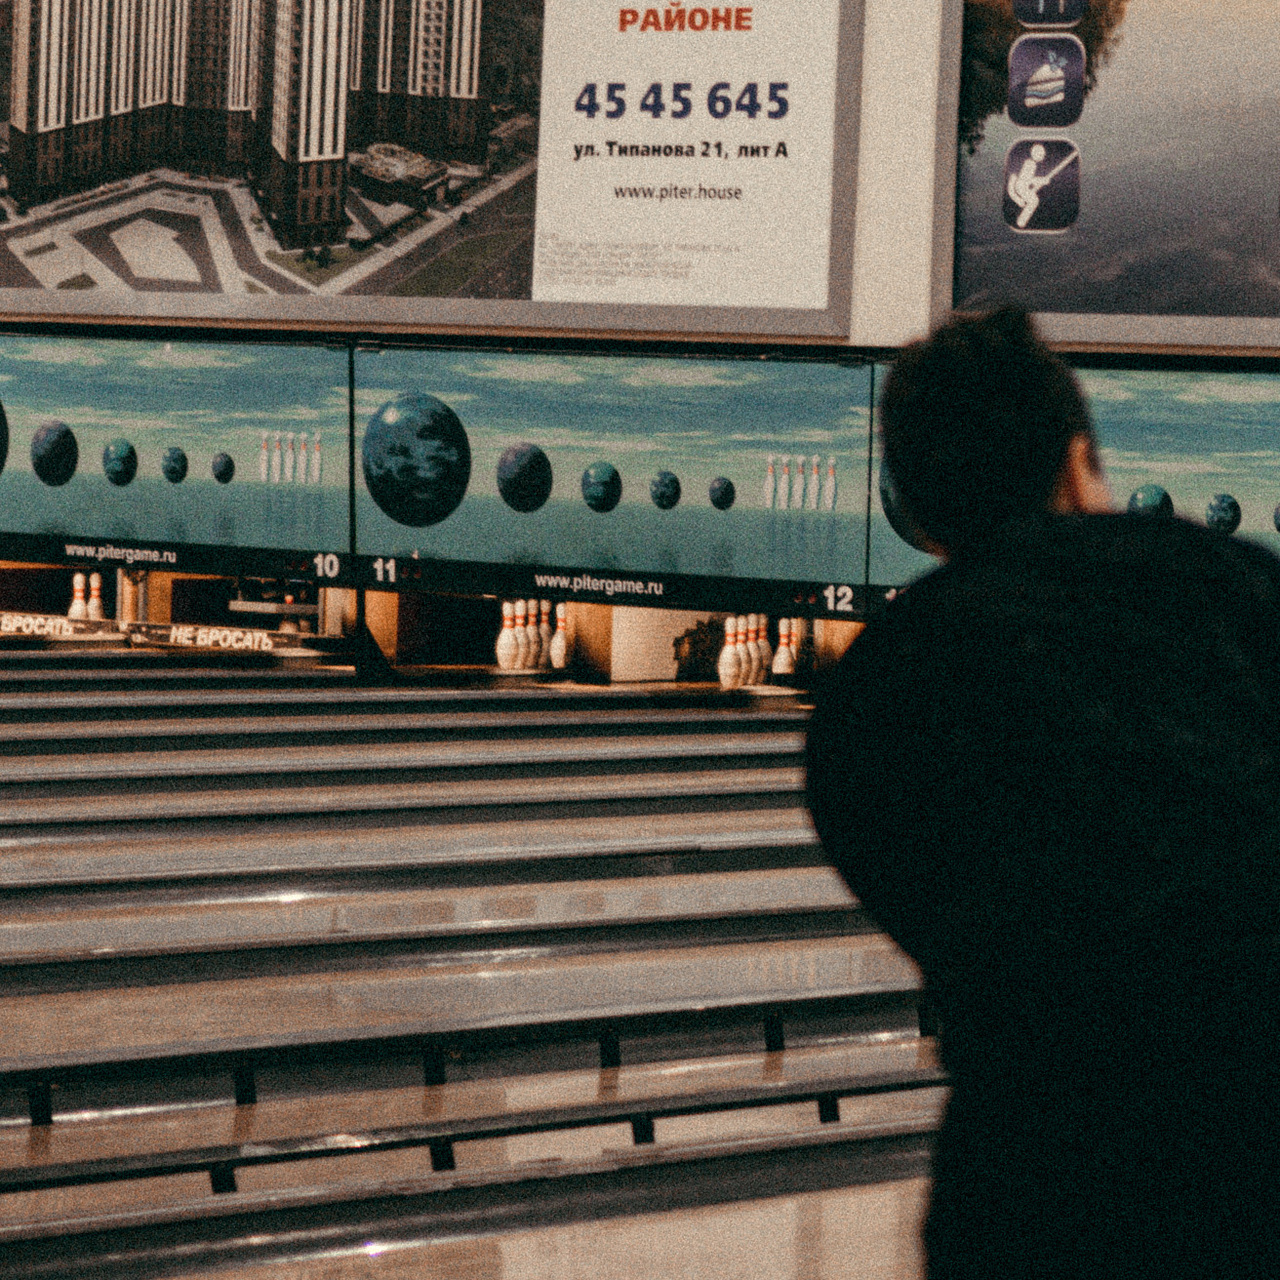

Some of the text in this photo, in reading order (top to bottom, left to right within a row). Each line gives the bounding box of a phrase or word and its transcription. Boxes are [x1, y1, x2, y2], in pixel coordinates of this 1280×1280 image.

[619, 2, 752, 32] РАЙОНЕ
[574, 82, 789, 120] 45 45 645
[573, 141, 788, 161] ул. Типанова 21, лит А
[614, 183, 742, 202] www.piter.house
[65, 542, 177, 564] www.pitergame.ru
[313, 552, 339, 578] 10
[373, 558, 397, 583] 11
[535, 572, 663, 596] www.pitergame.ru
[823, 584, 854, 612] 12
[170, 625, 273, 651] НЕ БРОСАТЬ
